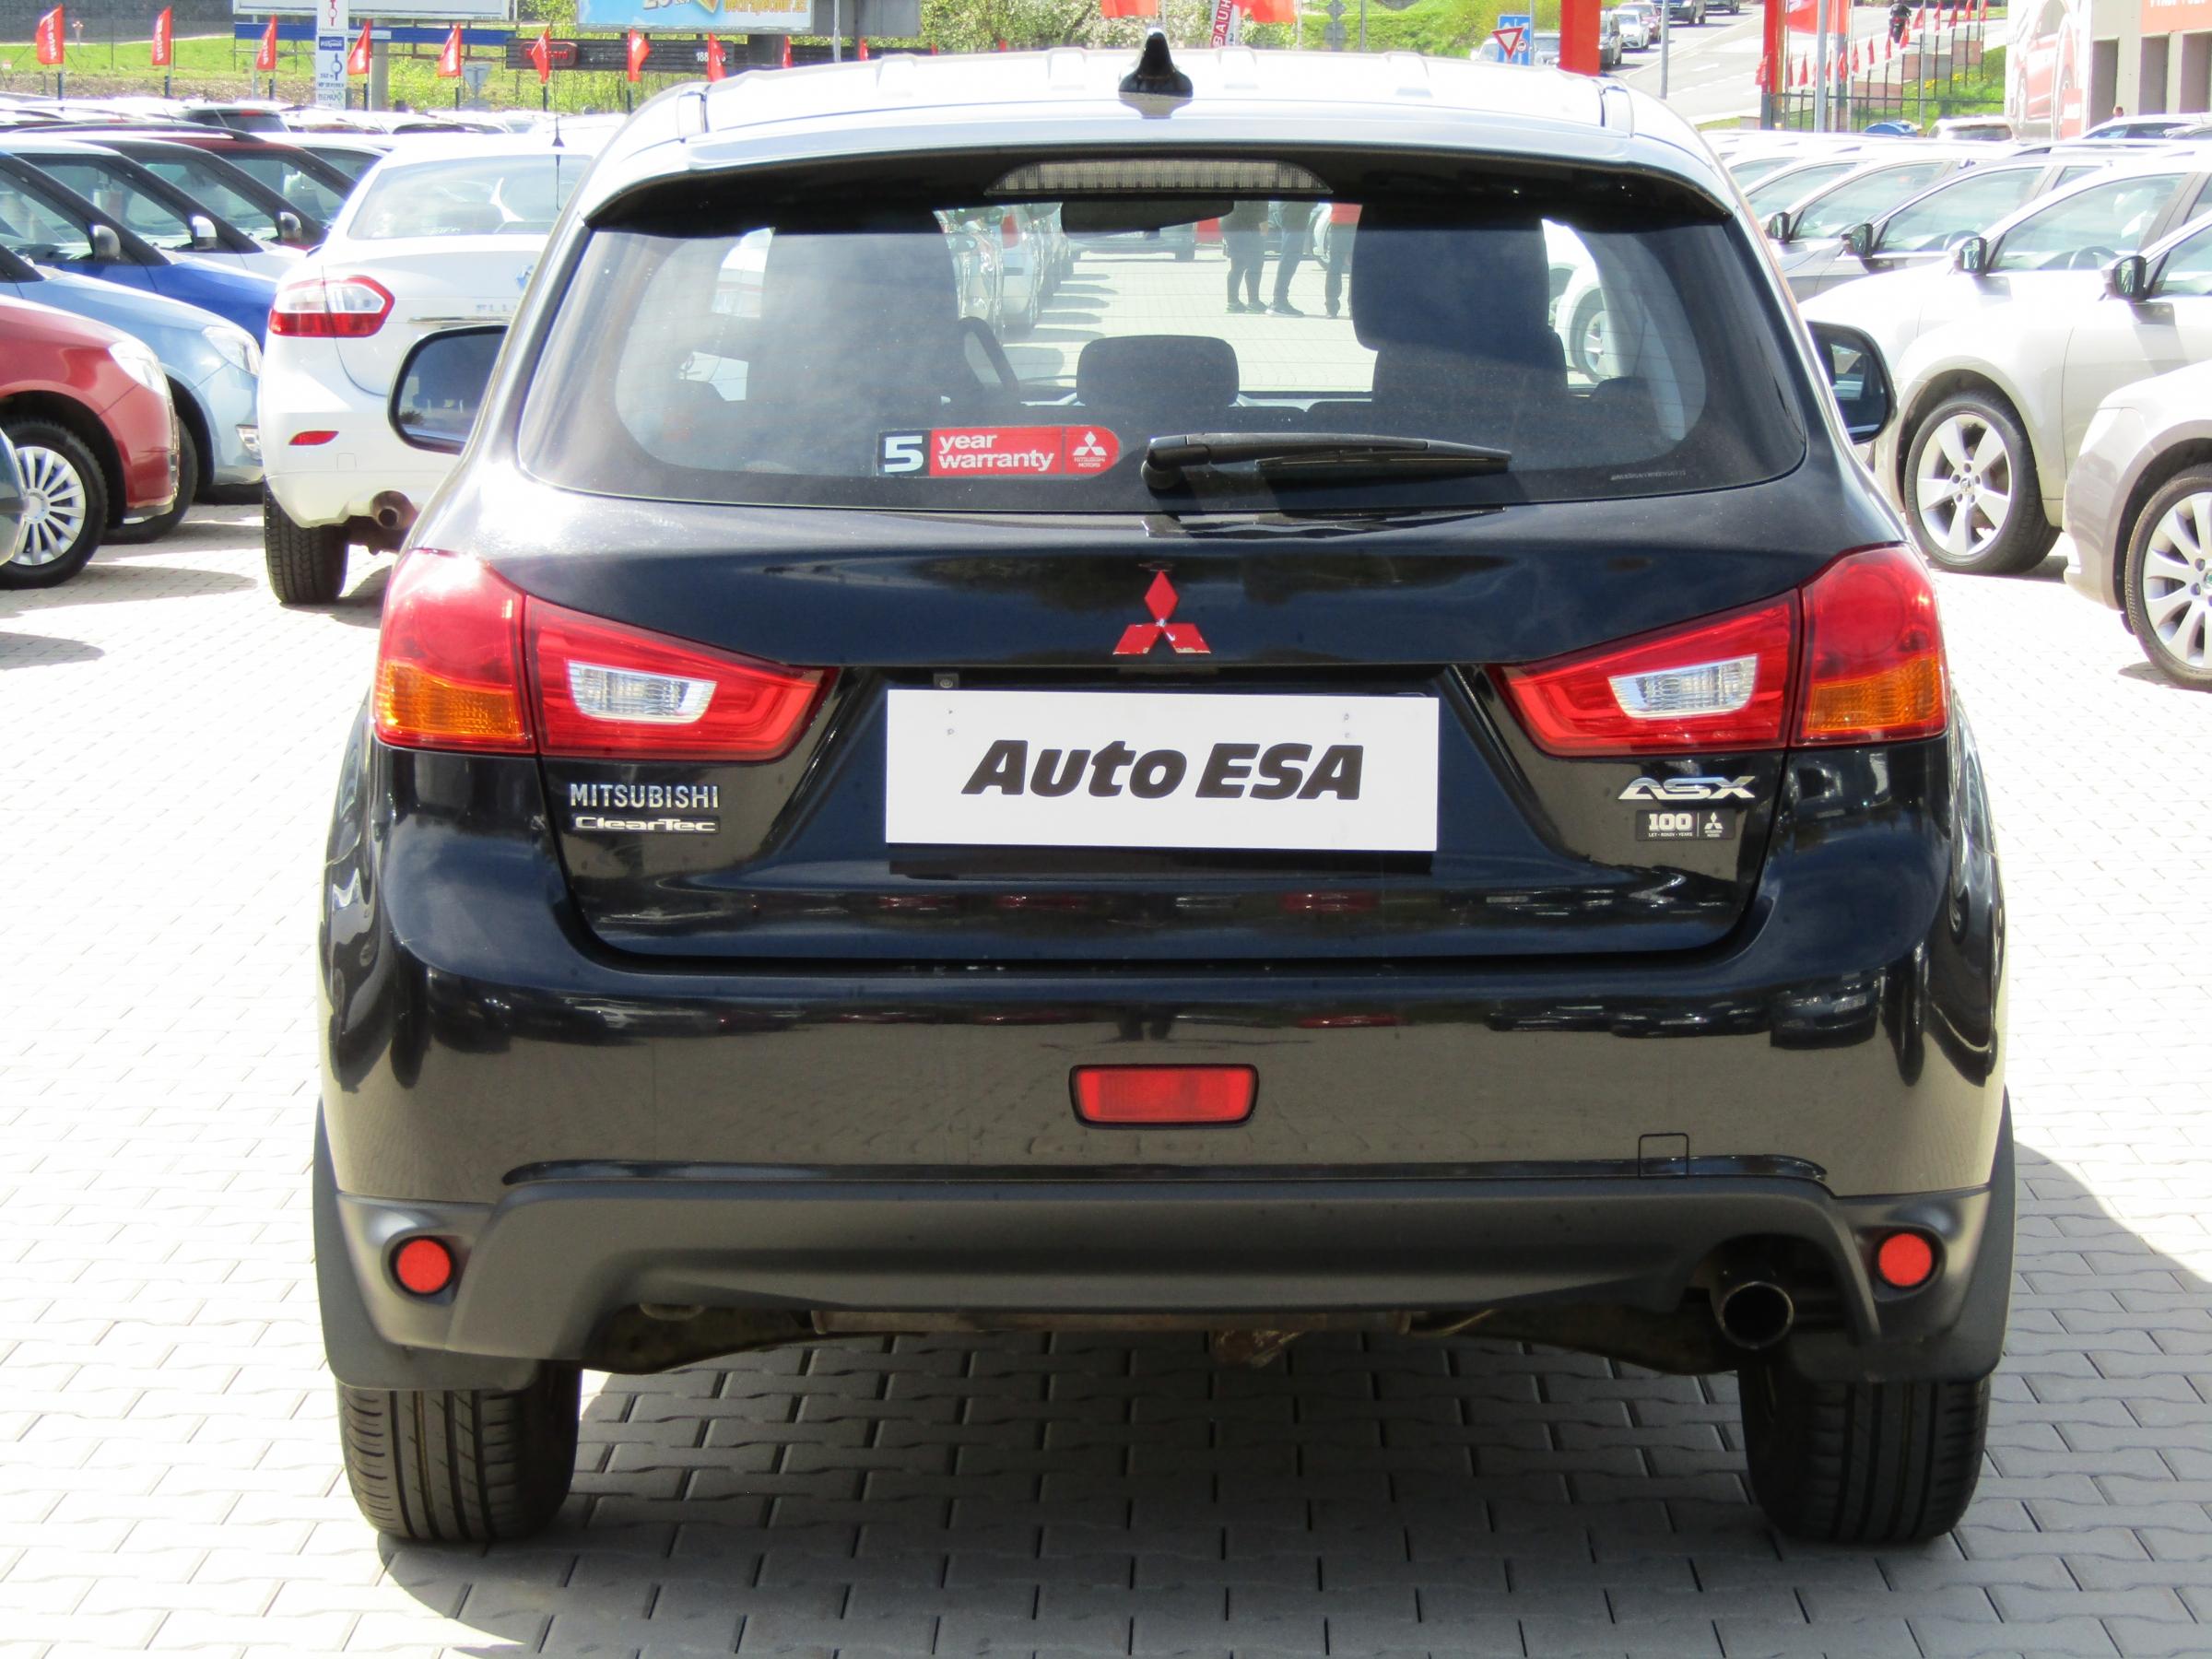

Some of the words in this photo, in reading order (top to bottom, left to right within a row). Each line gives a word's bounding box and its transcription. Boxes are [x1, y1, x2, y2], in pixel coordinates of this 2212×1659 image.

[884, 435, 924, 474] 5
[938, 433, 998, 454] year
[937, 449, 1055, 472] warranty
[960, 739, 1188, 800] Auto
[1194, 742, 1365, 801] ESA
[570, 783, 720, 809] MITSUBISHI
[1618, 775, 1756, 801] ASX
[575, 816, 717, 832] ClearTec
[1648, 812, 1694, 831] 100
